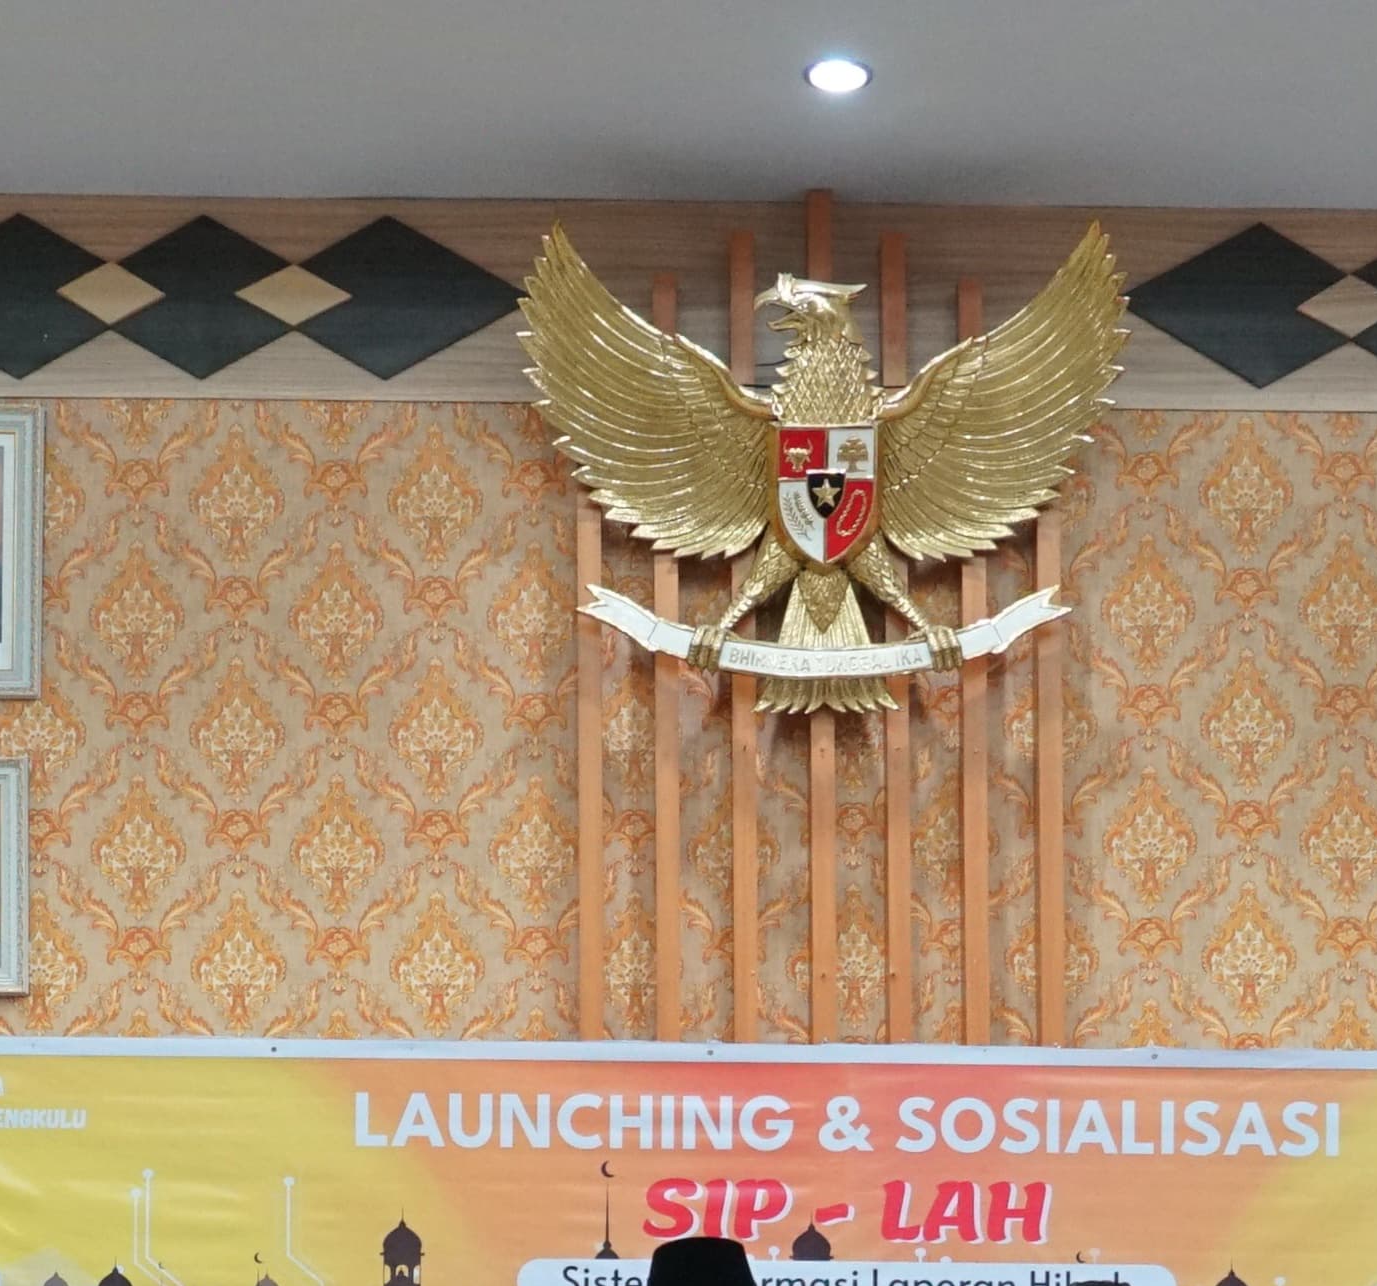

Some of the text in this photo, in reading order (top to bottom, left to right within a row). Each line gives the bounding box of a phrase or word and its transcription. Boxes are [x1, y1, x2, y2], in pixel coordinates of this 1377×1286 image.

[354, 1092, 1340, 1156] LAUNCHING & SOSIALISASI
[642, 1178, 794, 1241] SIP
[880, 1180, 1053, 1245] LAH
